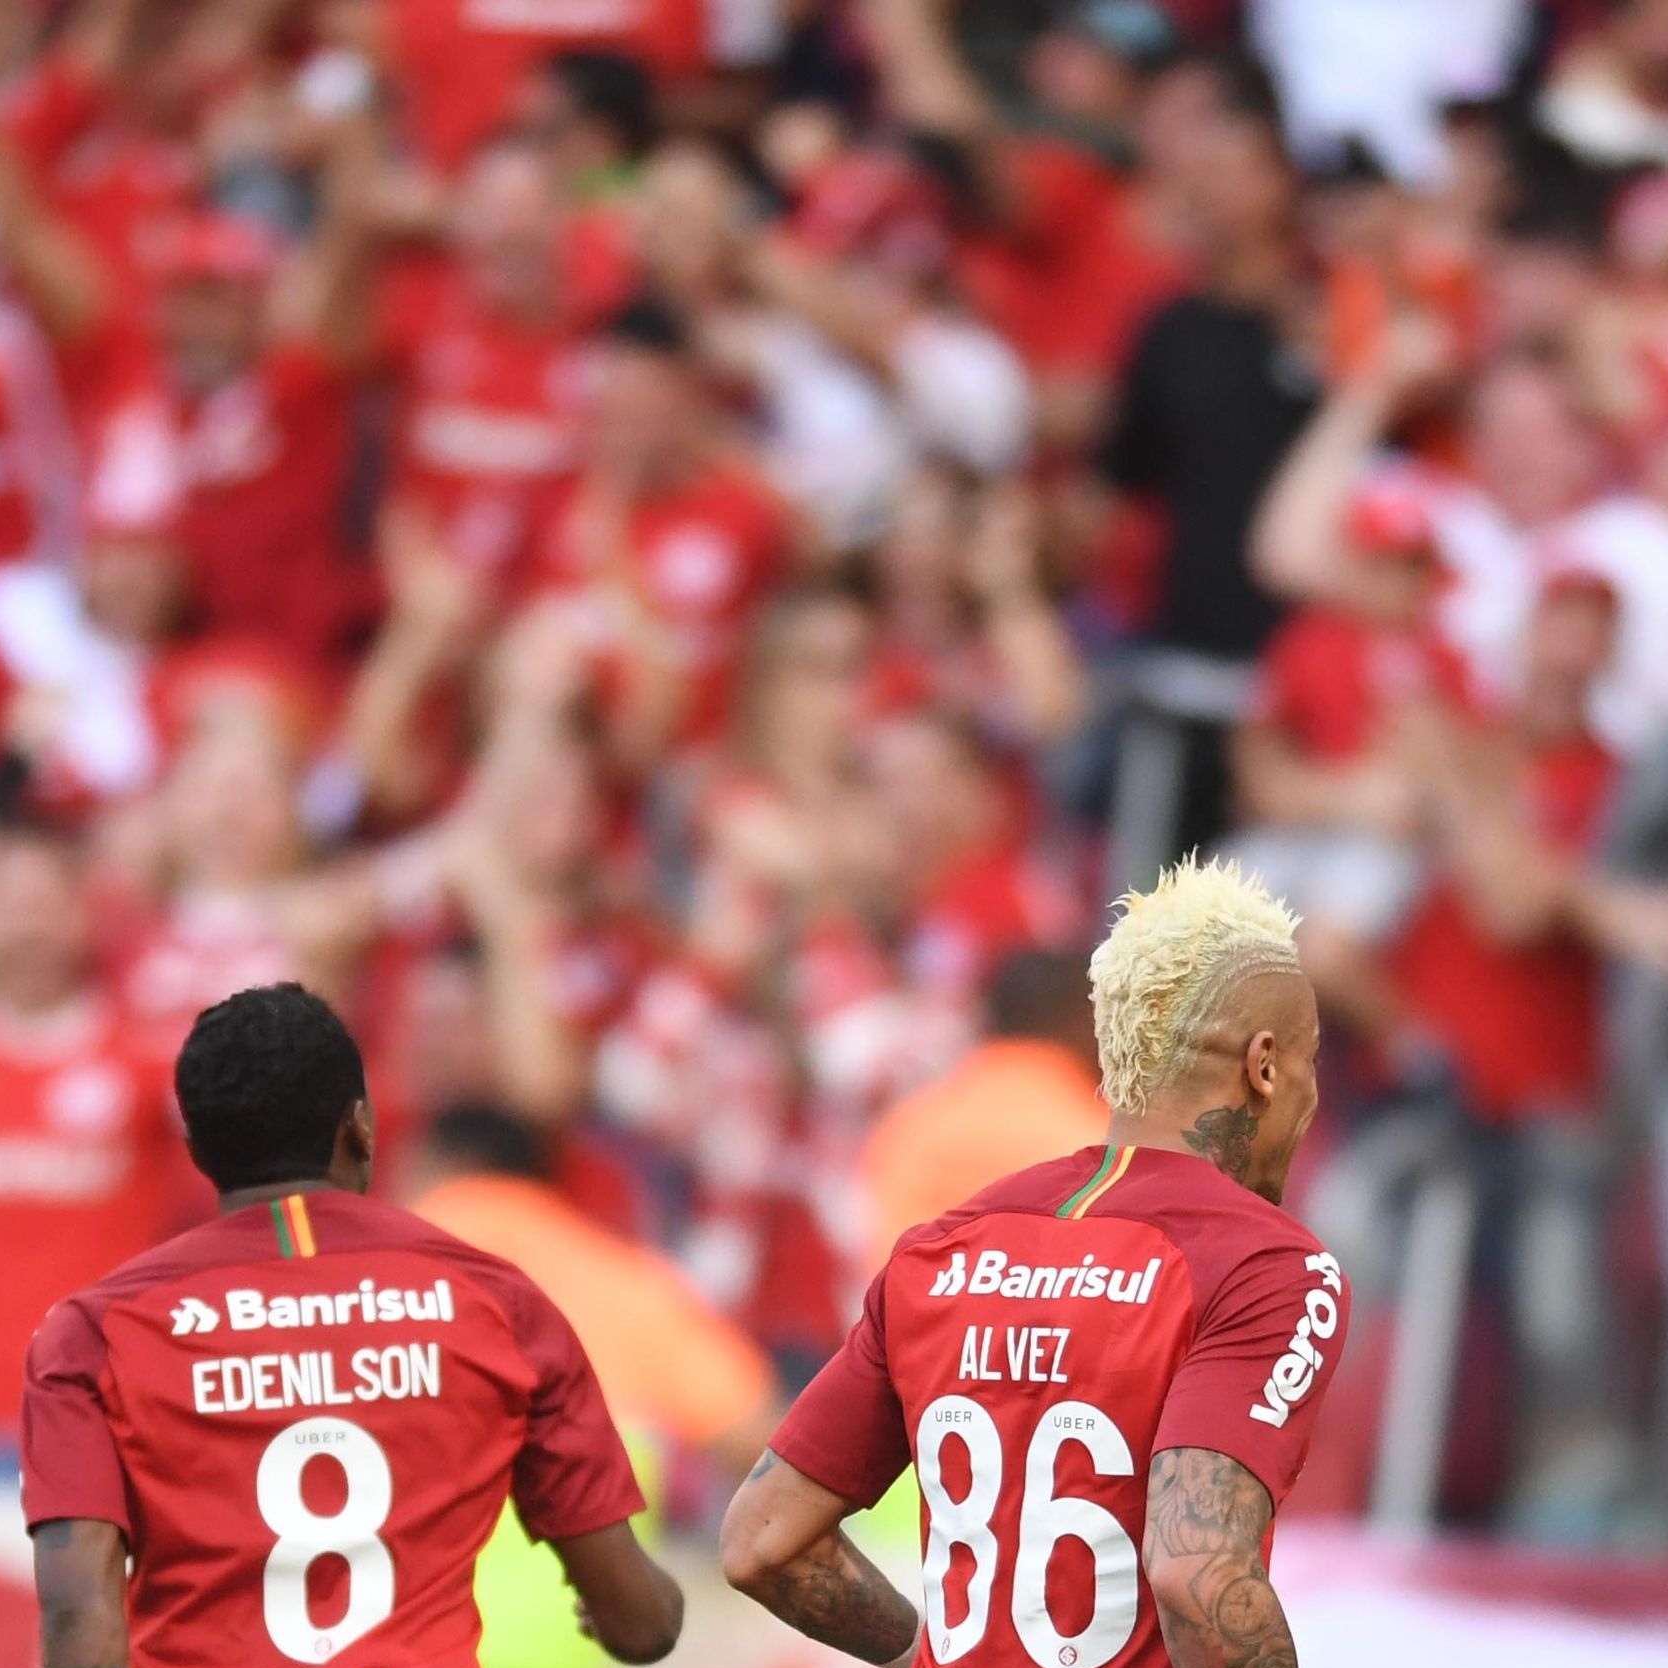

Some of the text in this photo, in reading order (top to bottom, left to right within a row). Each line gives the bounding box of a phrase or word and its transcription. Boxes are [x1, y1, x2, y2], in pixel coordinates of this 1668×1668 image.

[968, 1250, 1162, 1304] Banrisul
[224, 1279, 454, 1331] Banrisul
[191, 1343, 441, 1414] EDENILSON
[957, 1325, 1071, 1384] ALVEZ
[294, 1431, 346, 1445] UBER
[935, 1409, 973, 1424] UBER
[1053, 1416, 1096, 1431] UBER
[256, 1416, 395, 1665] 8
